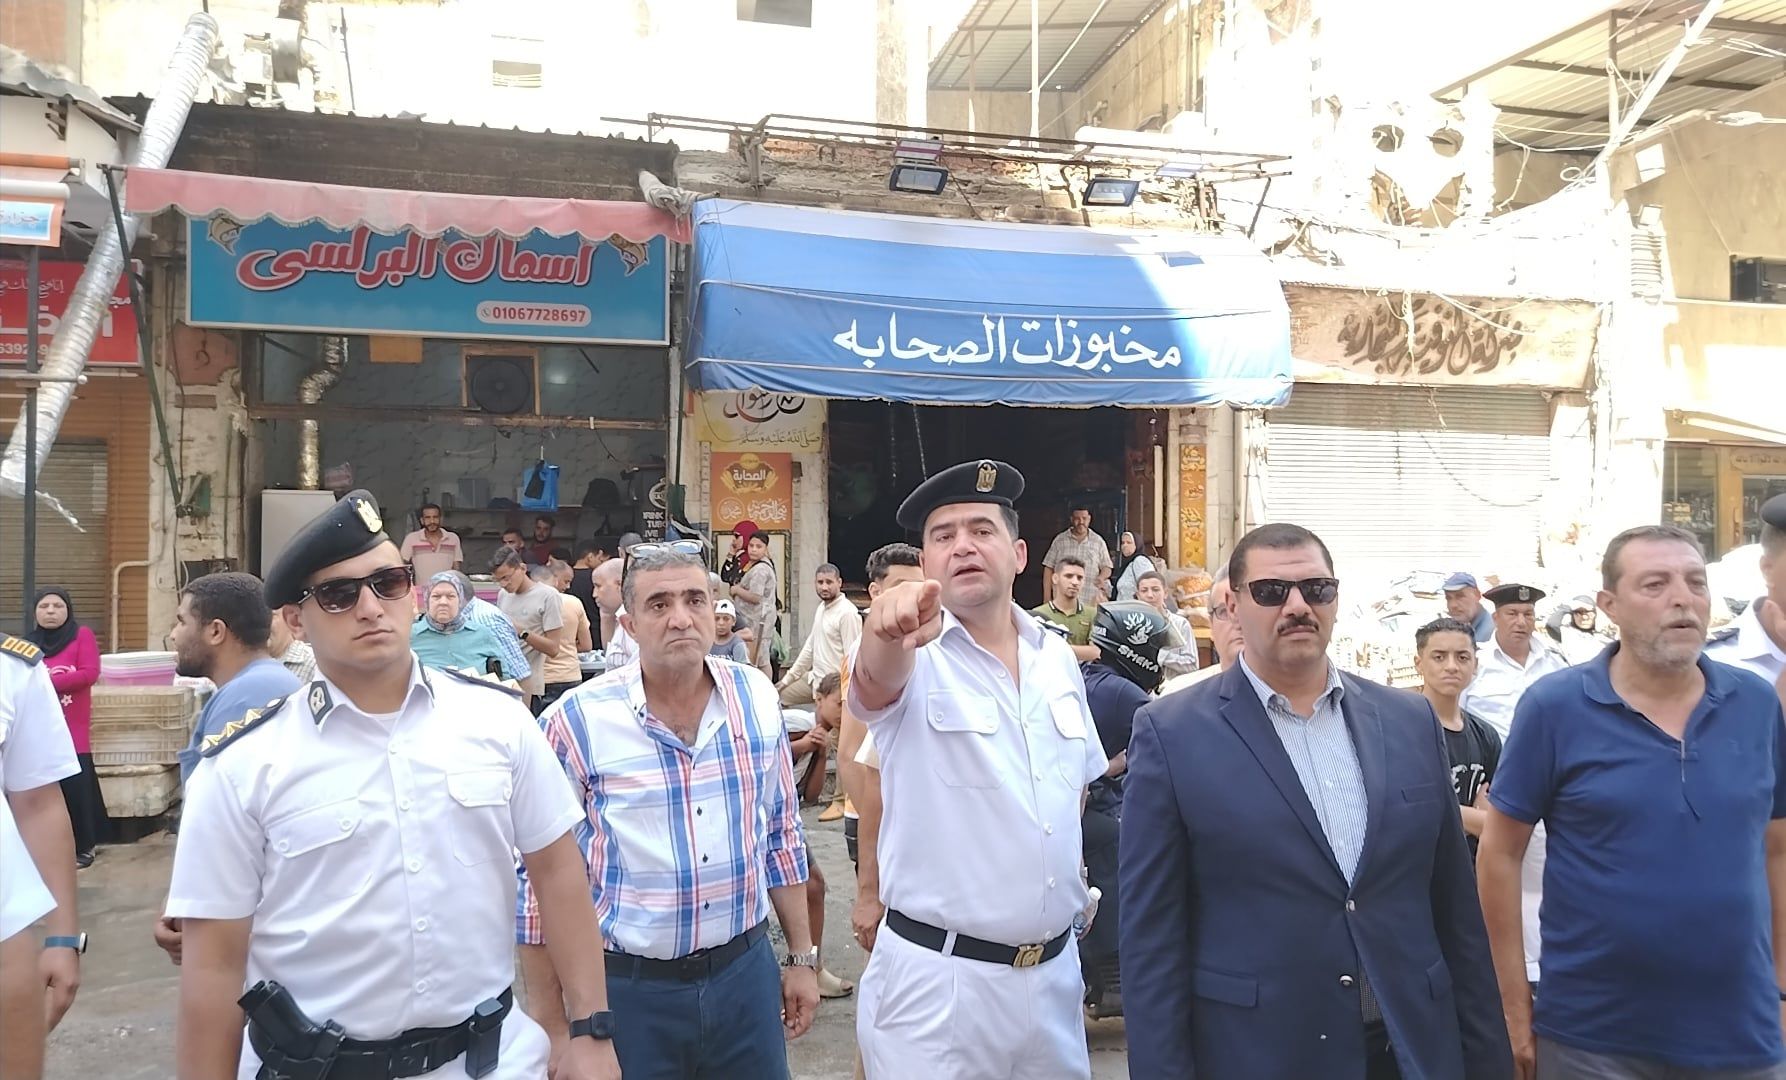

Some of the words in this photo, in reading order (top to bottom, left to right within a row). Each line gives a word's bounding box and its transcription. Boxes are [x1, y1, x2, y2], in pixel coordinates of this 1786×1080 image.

[492, 307, 586, 323] 01067728697
[832, 312, 1006, 368] الصحابه
[1011, 313, 1182, 373] مخبوزات
